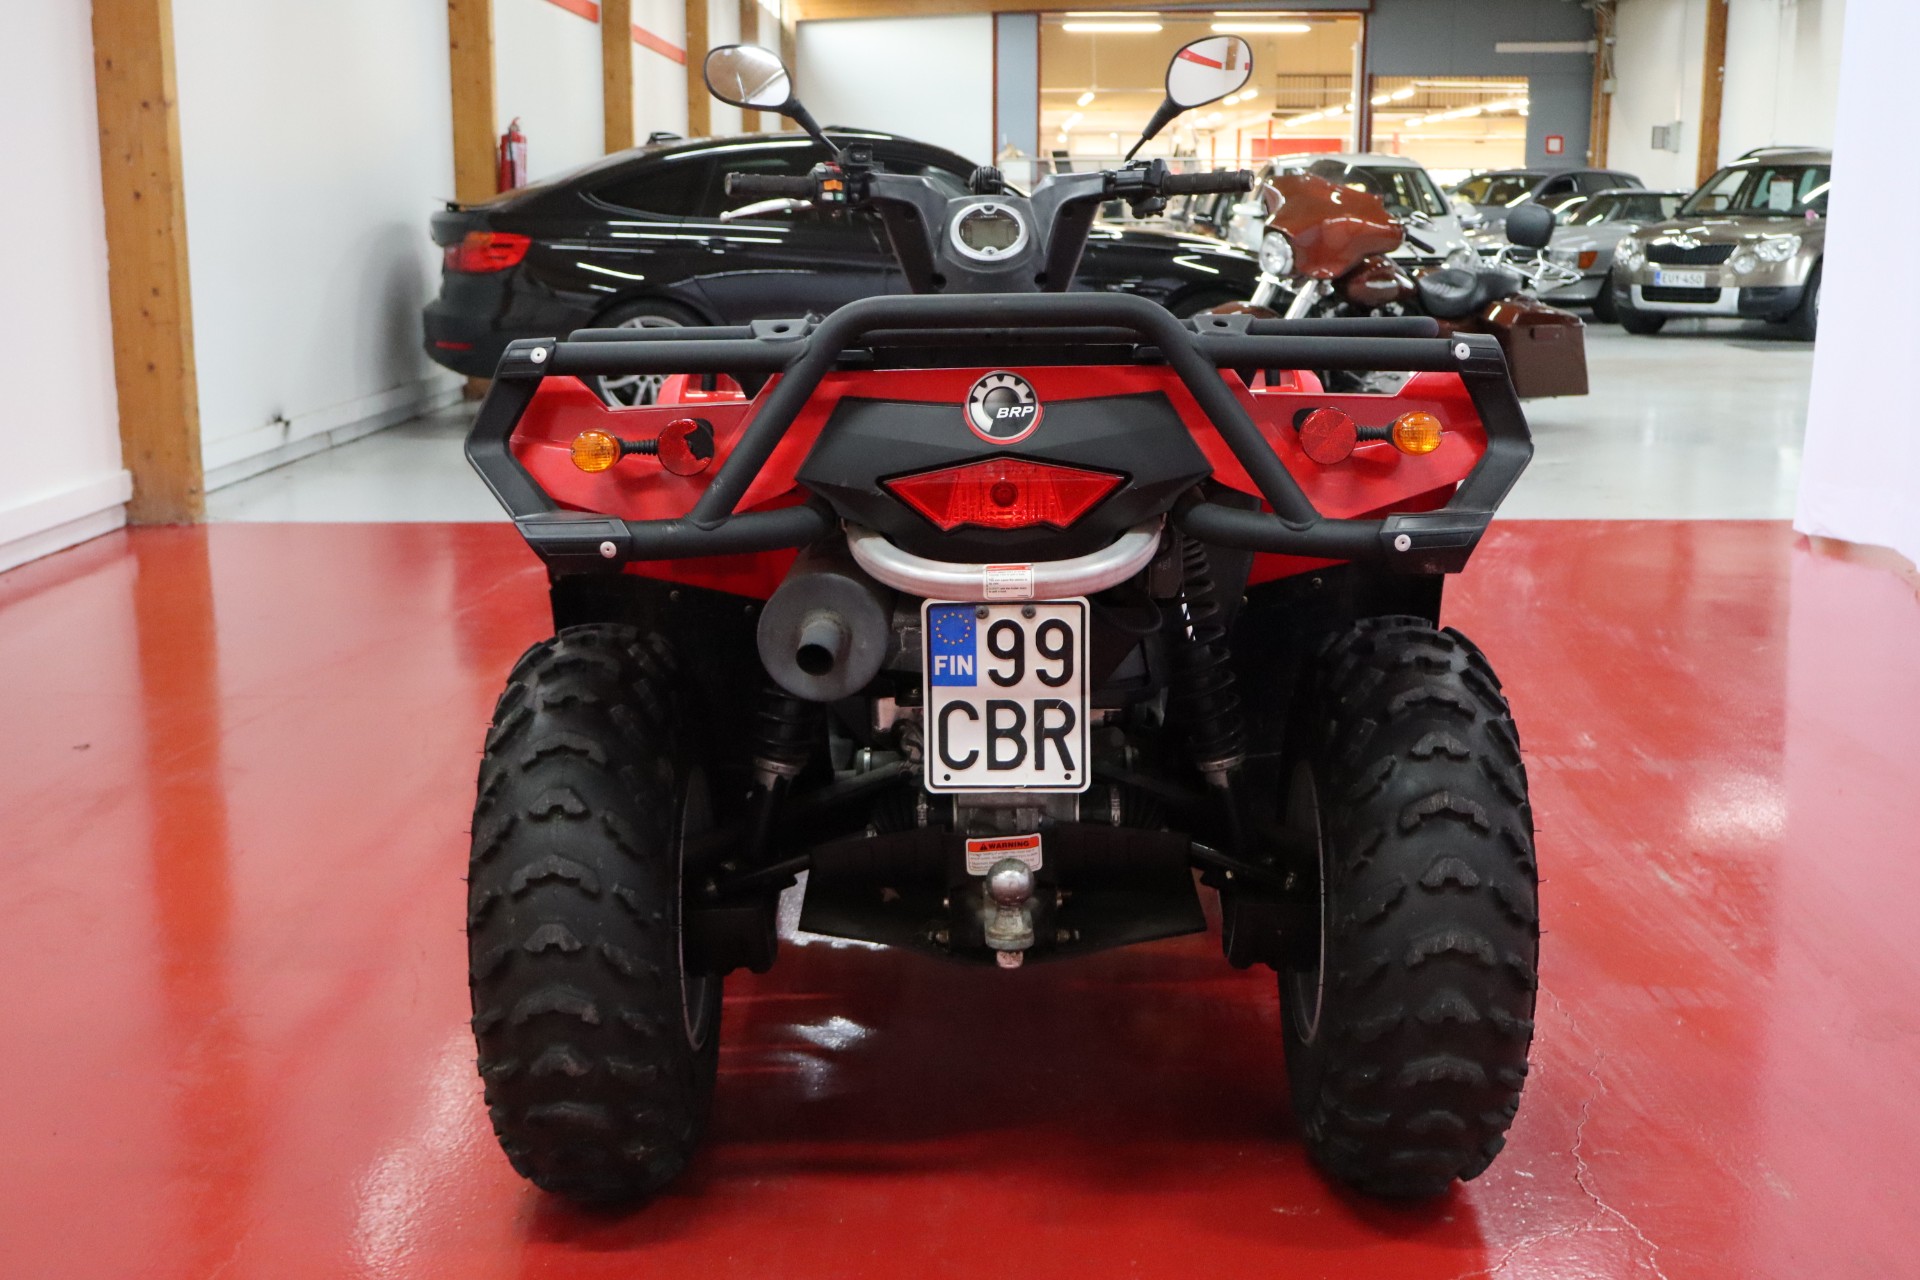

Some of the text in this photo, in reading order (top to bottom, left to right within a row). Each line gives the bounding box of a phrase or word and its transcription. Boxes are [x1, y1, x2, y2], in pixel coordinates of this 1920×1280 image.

[996, 405, 1034, 418] BRP
[987, 618, 1074, 687] 99
[934, 655, 973, 676] FIN
[938, 699, 1076, 771] CBR
[988, 840, 1030, 849] WARNING
